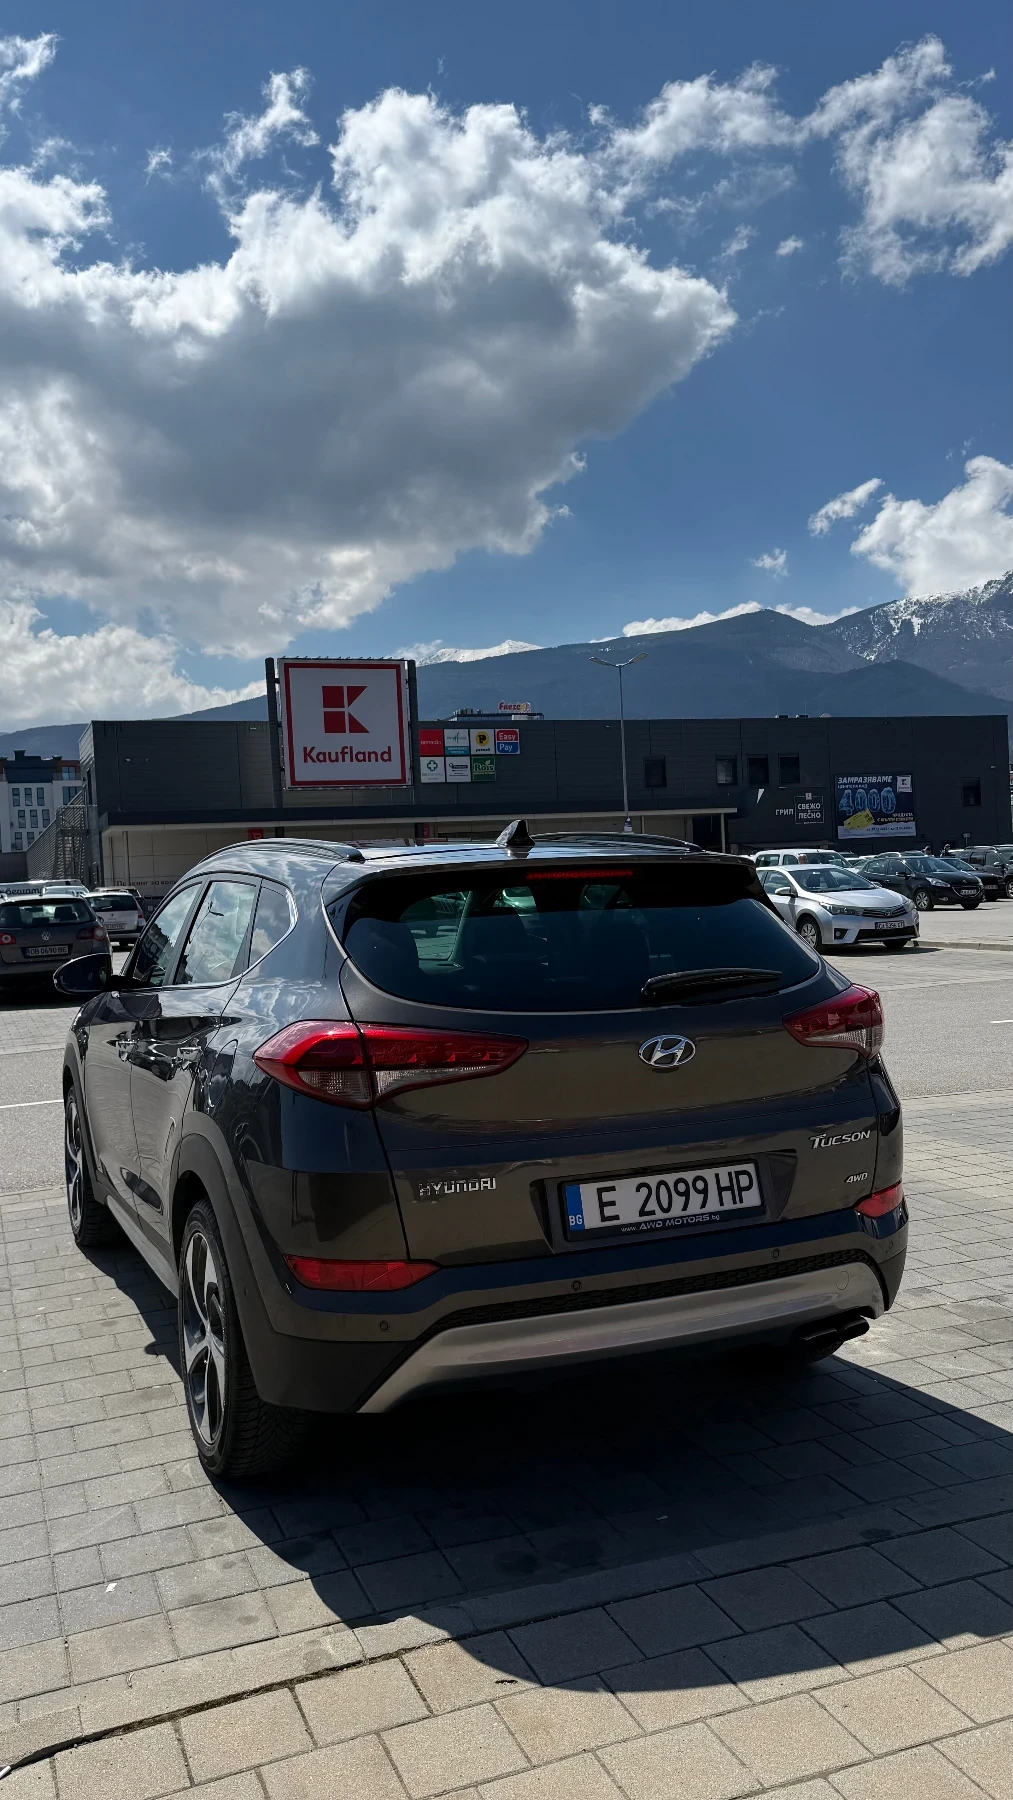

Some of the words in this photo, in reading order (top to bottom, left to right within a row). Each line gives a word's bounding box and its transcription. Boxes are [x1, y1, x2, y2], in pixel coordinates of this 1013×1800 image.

[499, 733, 516, 741] Easy
[303, 746, 392, 763] Kaufland
[500, 744, 513, 752] Pay
[838, 776, 893, 784] ЗАМРАЗЯВАМЕ
[839, 787, 896, 816] 4000
[809, 1130, 870, 1149] TUCSON
[419, 1178, 496, 1196] HYUNDAI
[597, 1186, 620, 1222] E
[635, 1175, 709, 1217] 2099
[715, 1169, 754, 1206] HP
[569, 1214, 583, 1226] BG
